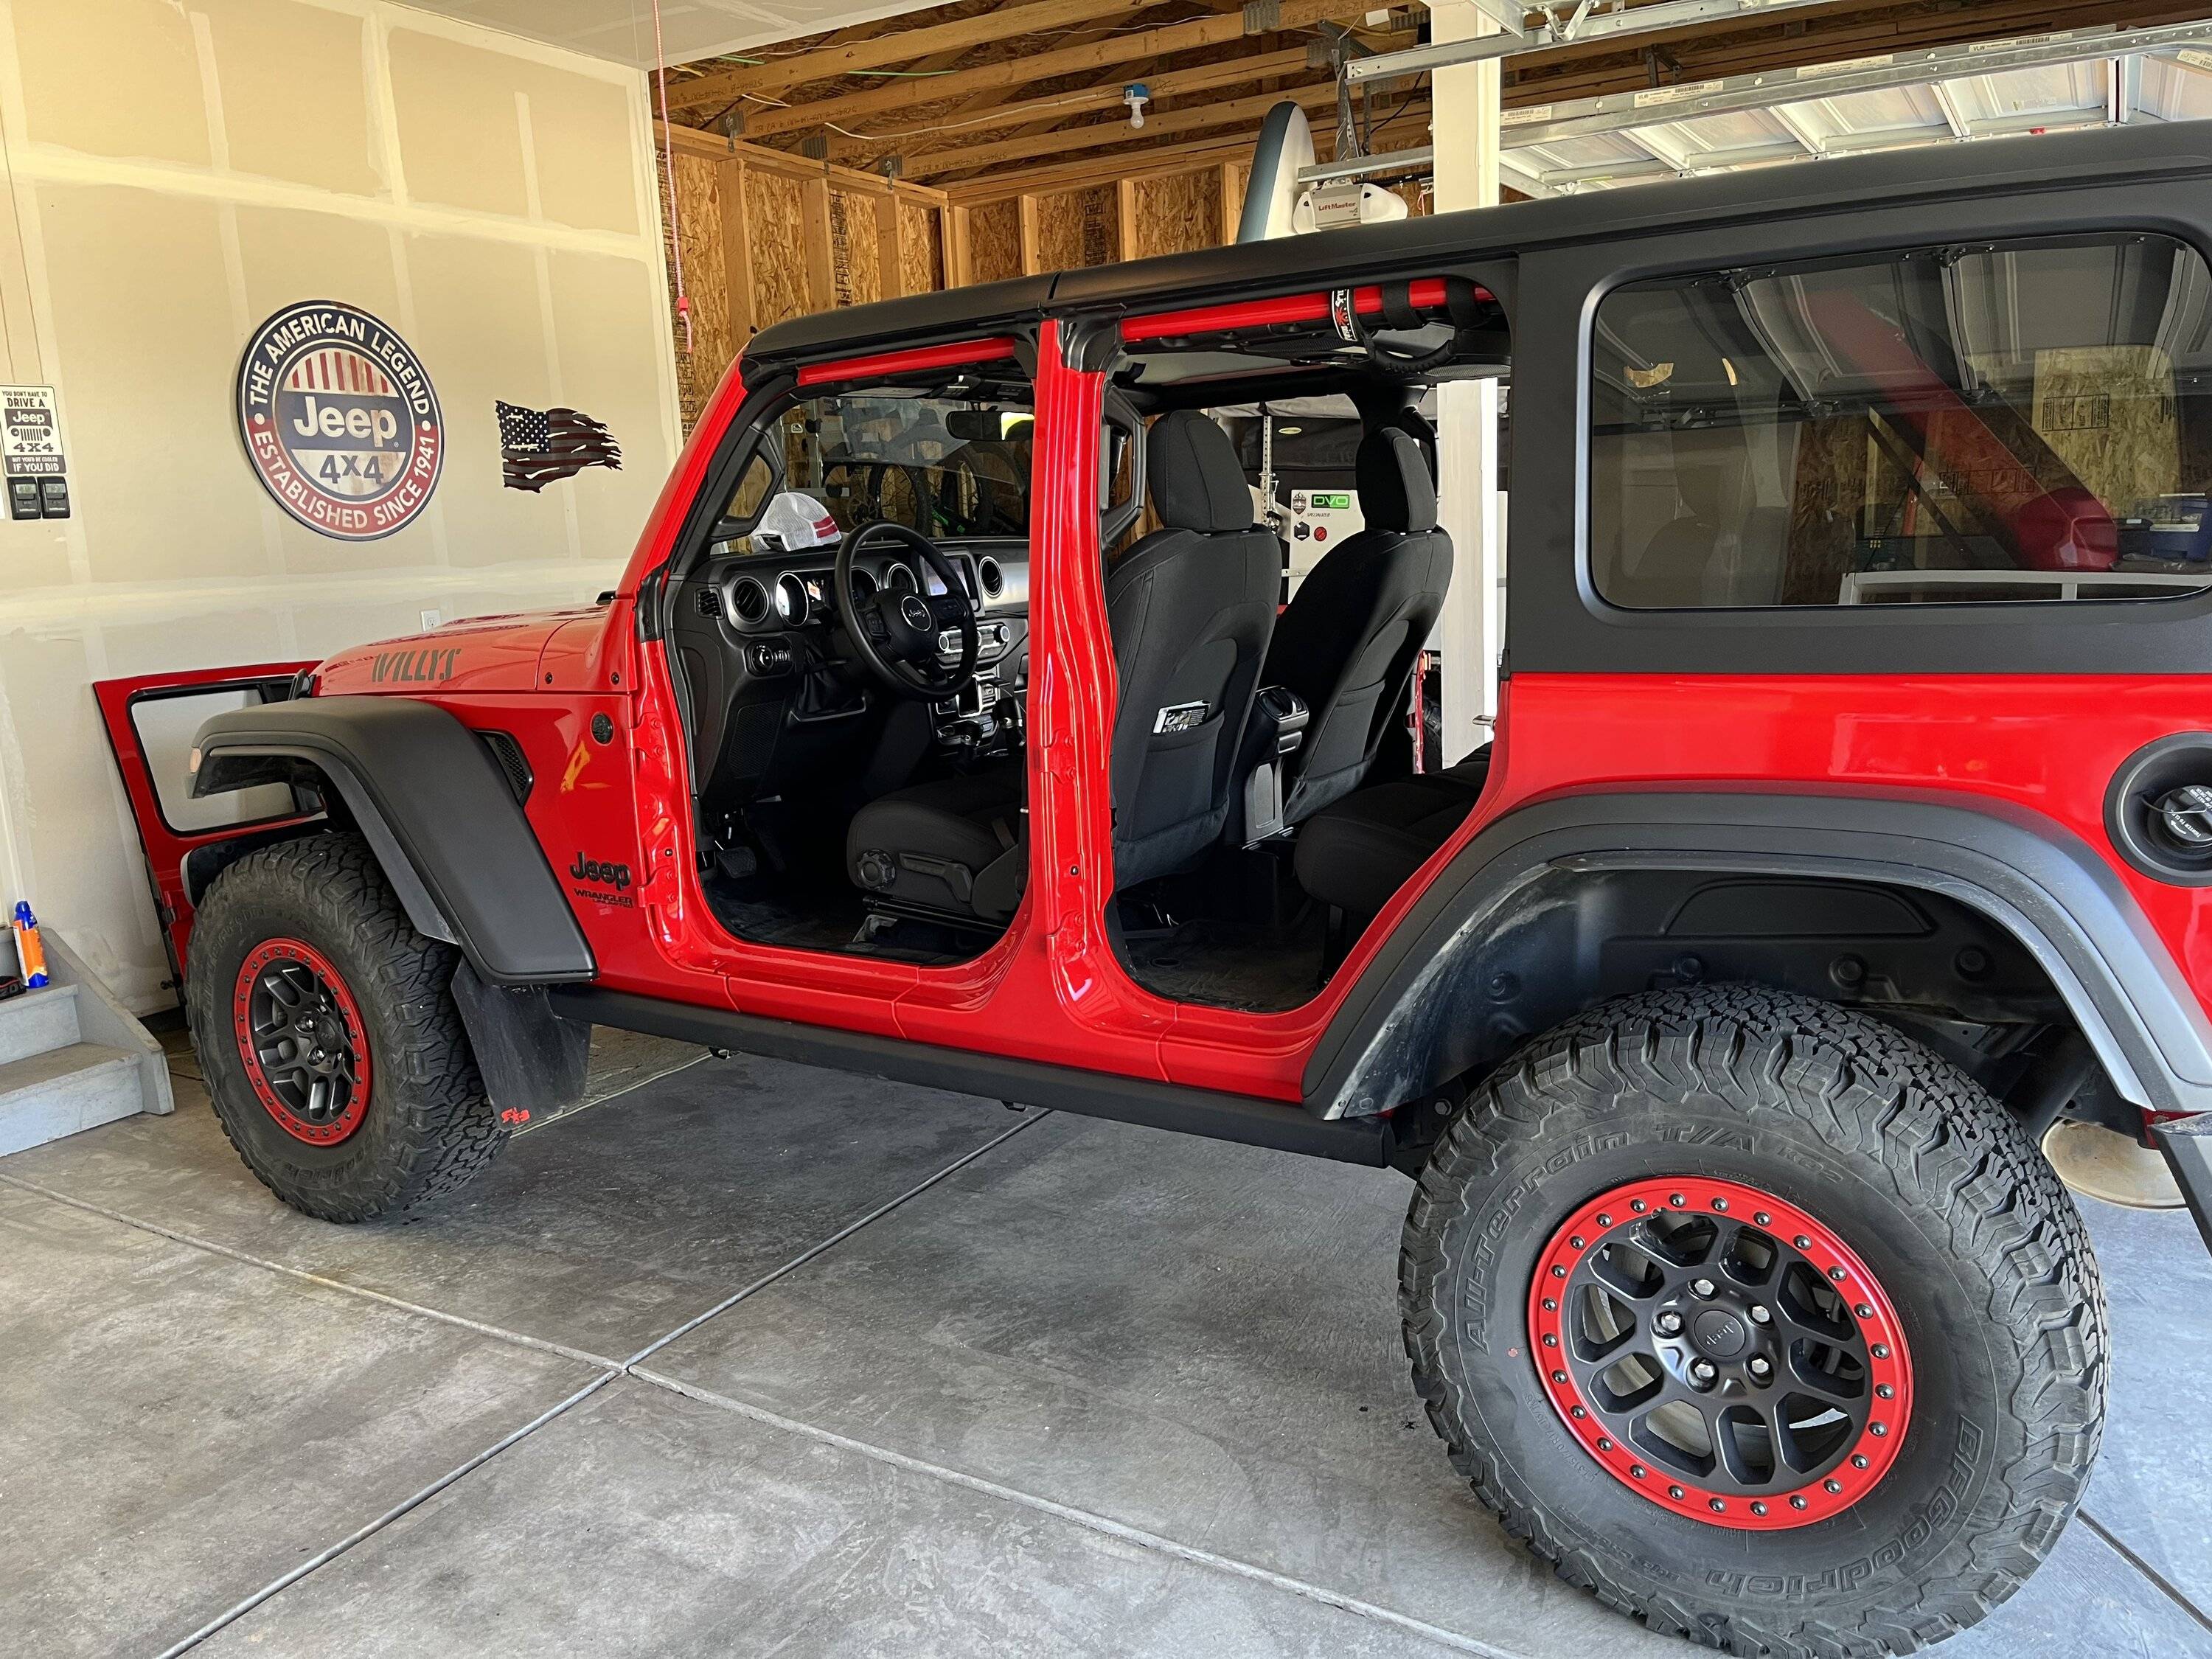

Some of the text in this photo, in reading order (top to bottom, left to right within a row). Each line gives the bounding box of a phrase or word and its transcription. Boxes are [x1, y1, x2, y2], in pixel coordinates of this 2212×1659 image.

[1318, 201, 1357, 212] LiftMaster
[249, 313, 431, 415] THE AMERICAN LEGEND
[7, 397, 46, 407] DRIVE A
[13, 411, 46, 425] Jeep
[293, 395, 398, 448] Jeep
[13, 442, 54, 452] 4X4
[13, 463, 60, 473] IF YOU DID
[254, 431, 436, 529] ESTABLISHED SINCE 1941
[1313, 495, 1349, 506] DVO
[371, 647, 462, 683] WILLYS
[570, 850, 632, 891] Jeep
[573, 887, 633, 904] WRANGLER
[1464, 1130, 1630, 1356] All-Terrain
[1705, 1414, 1984, 1601] BFGoodrich
